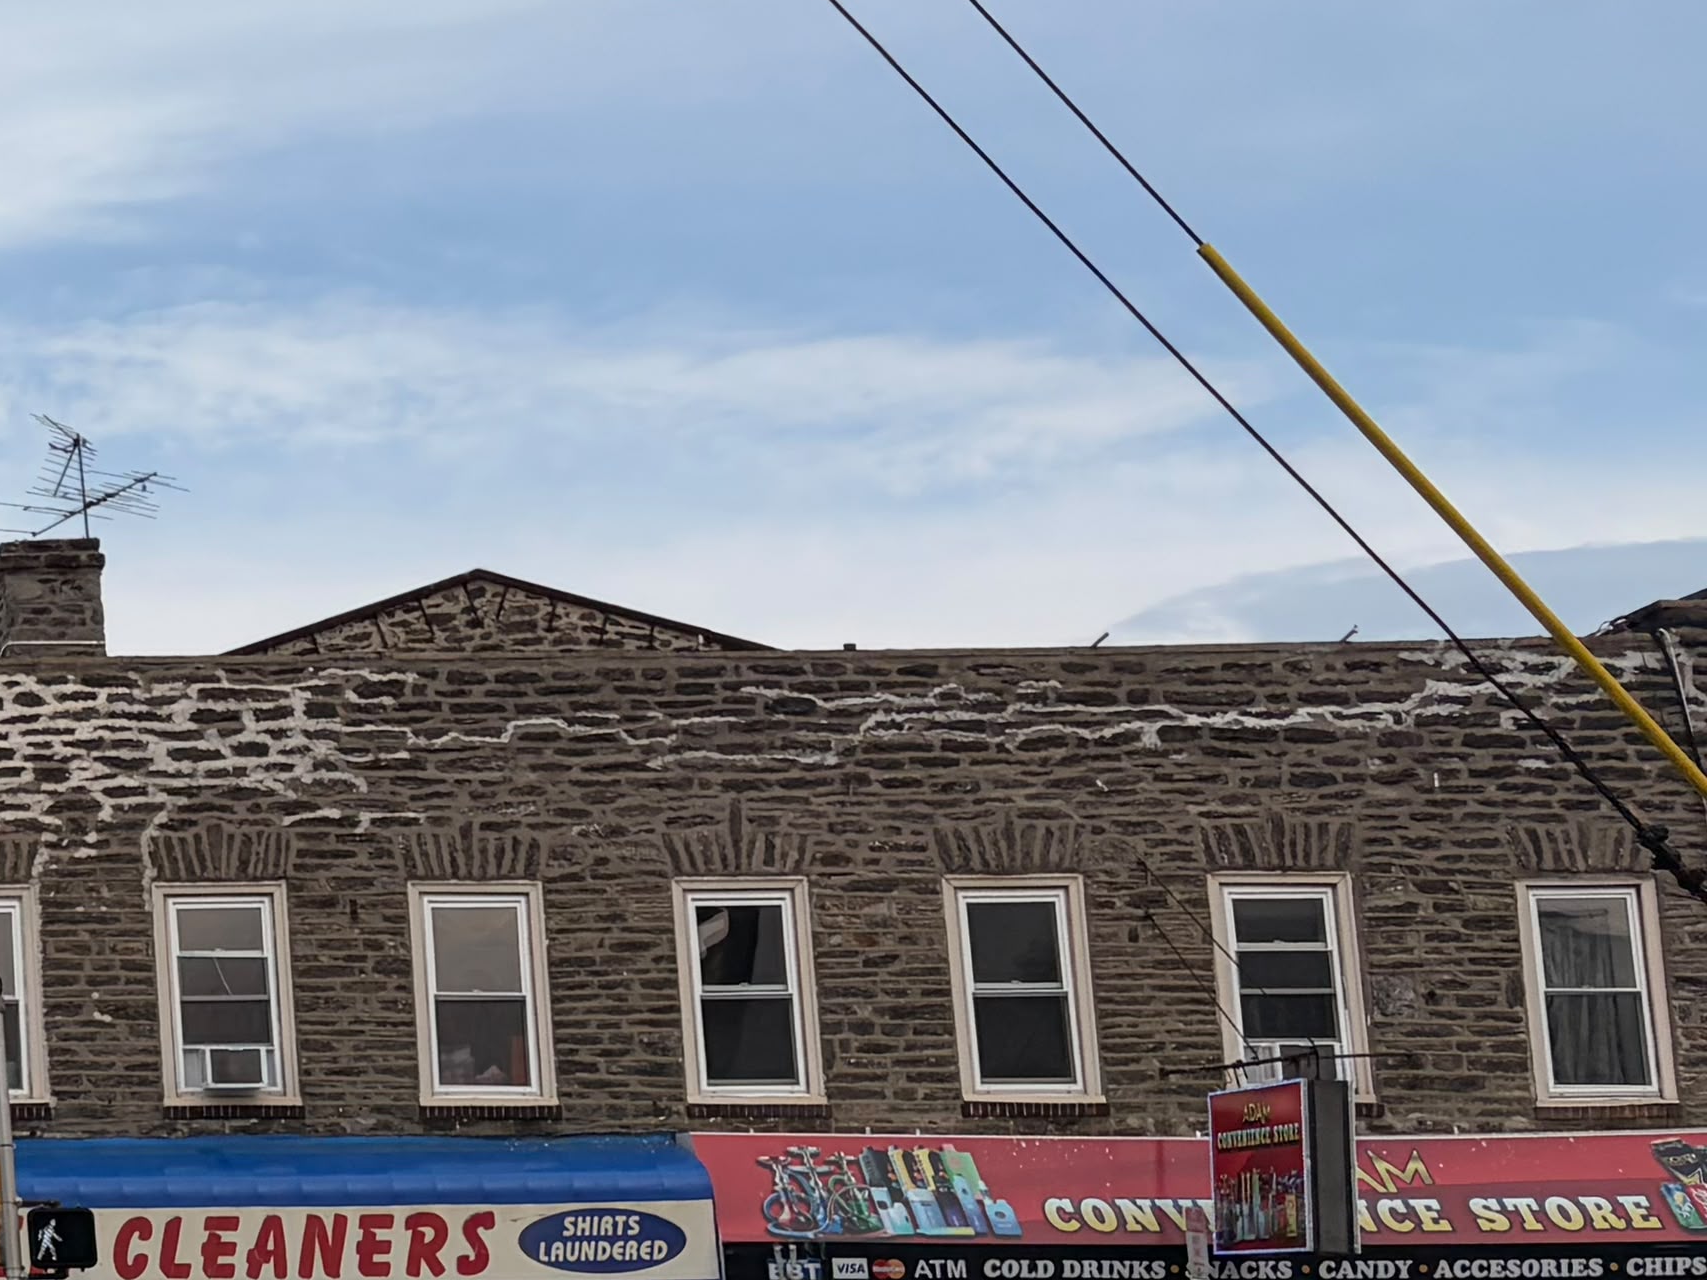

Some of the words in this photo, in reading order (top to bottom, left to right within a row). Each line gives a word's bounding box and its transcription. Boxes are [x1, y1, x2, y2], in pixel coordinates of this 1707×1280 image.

[1243, 1102, 1272, 1125] ADAM
[1217, 1125, 1272, 1150] CONVENIENCE
[1273, 1122, 1301, 1146] STORE
[1468, 1194, 1664, 1233] STORE
[561, 1215, 641, 1238] SHIRTS
[113, 1211, 496, 1280] CLEANERS
[538, 1239, 669, 1263] LAUNDERED
[837, 1261, 867, 1275] VISA
[914, 1259, 968, 1279] ATM
[983, 1258, 1056, 1280] COLD
[1061, 1258, 1167, 1280] DRINKS
[1318, 1259, 1414, 1280] CANDY
[1433, 1257, 1604, 1279] ACCESORIES
[1625, 1255, 1707, 1277] CHIPS
